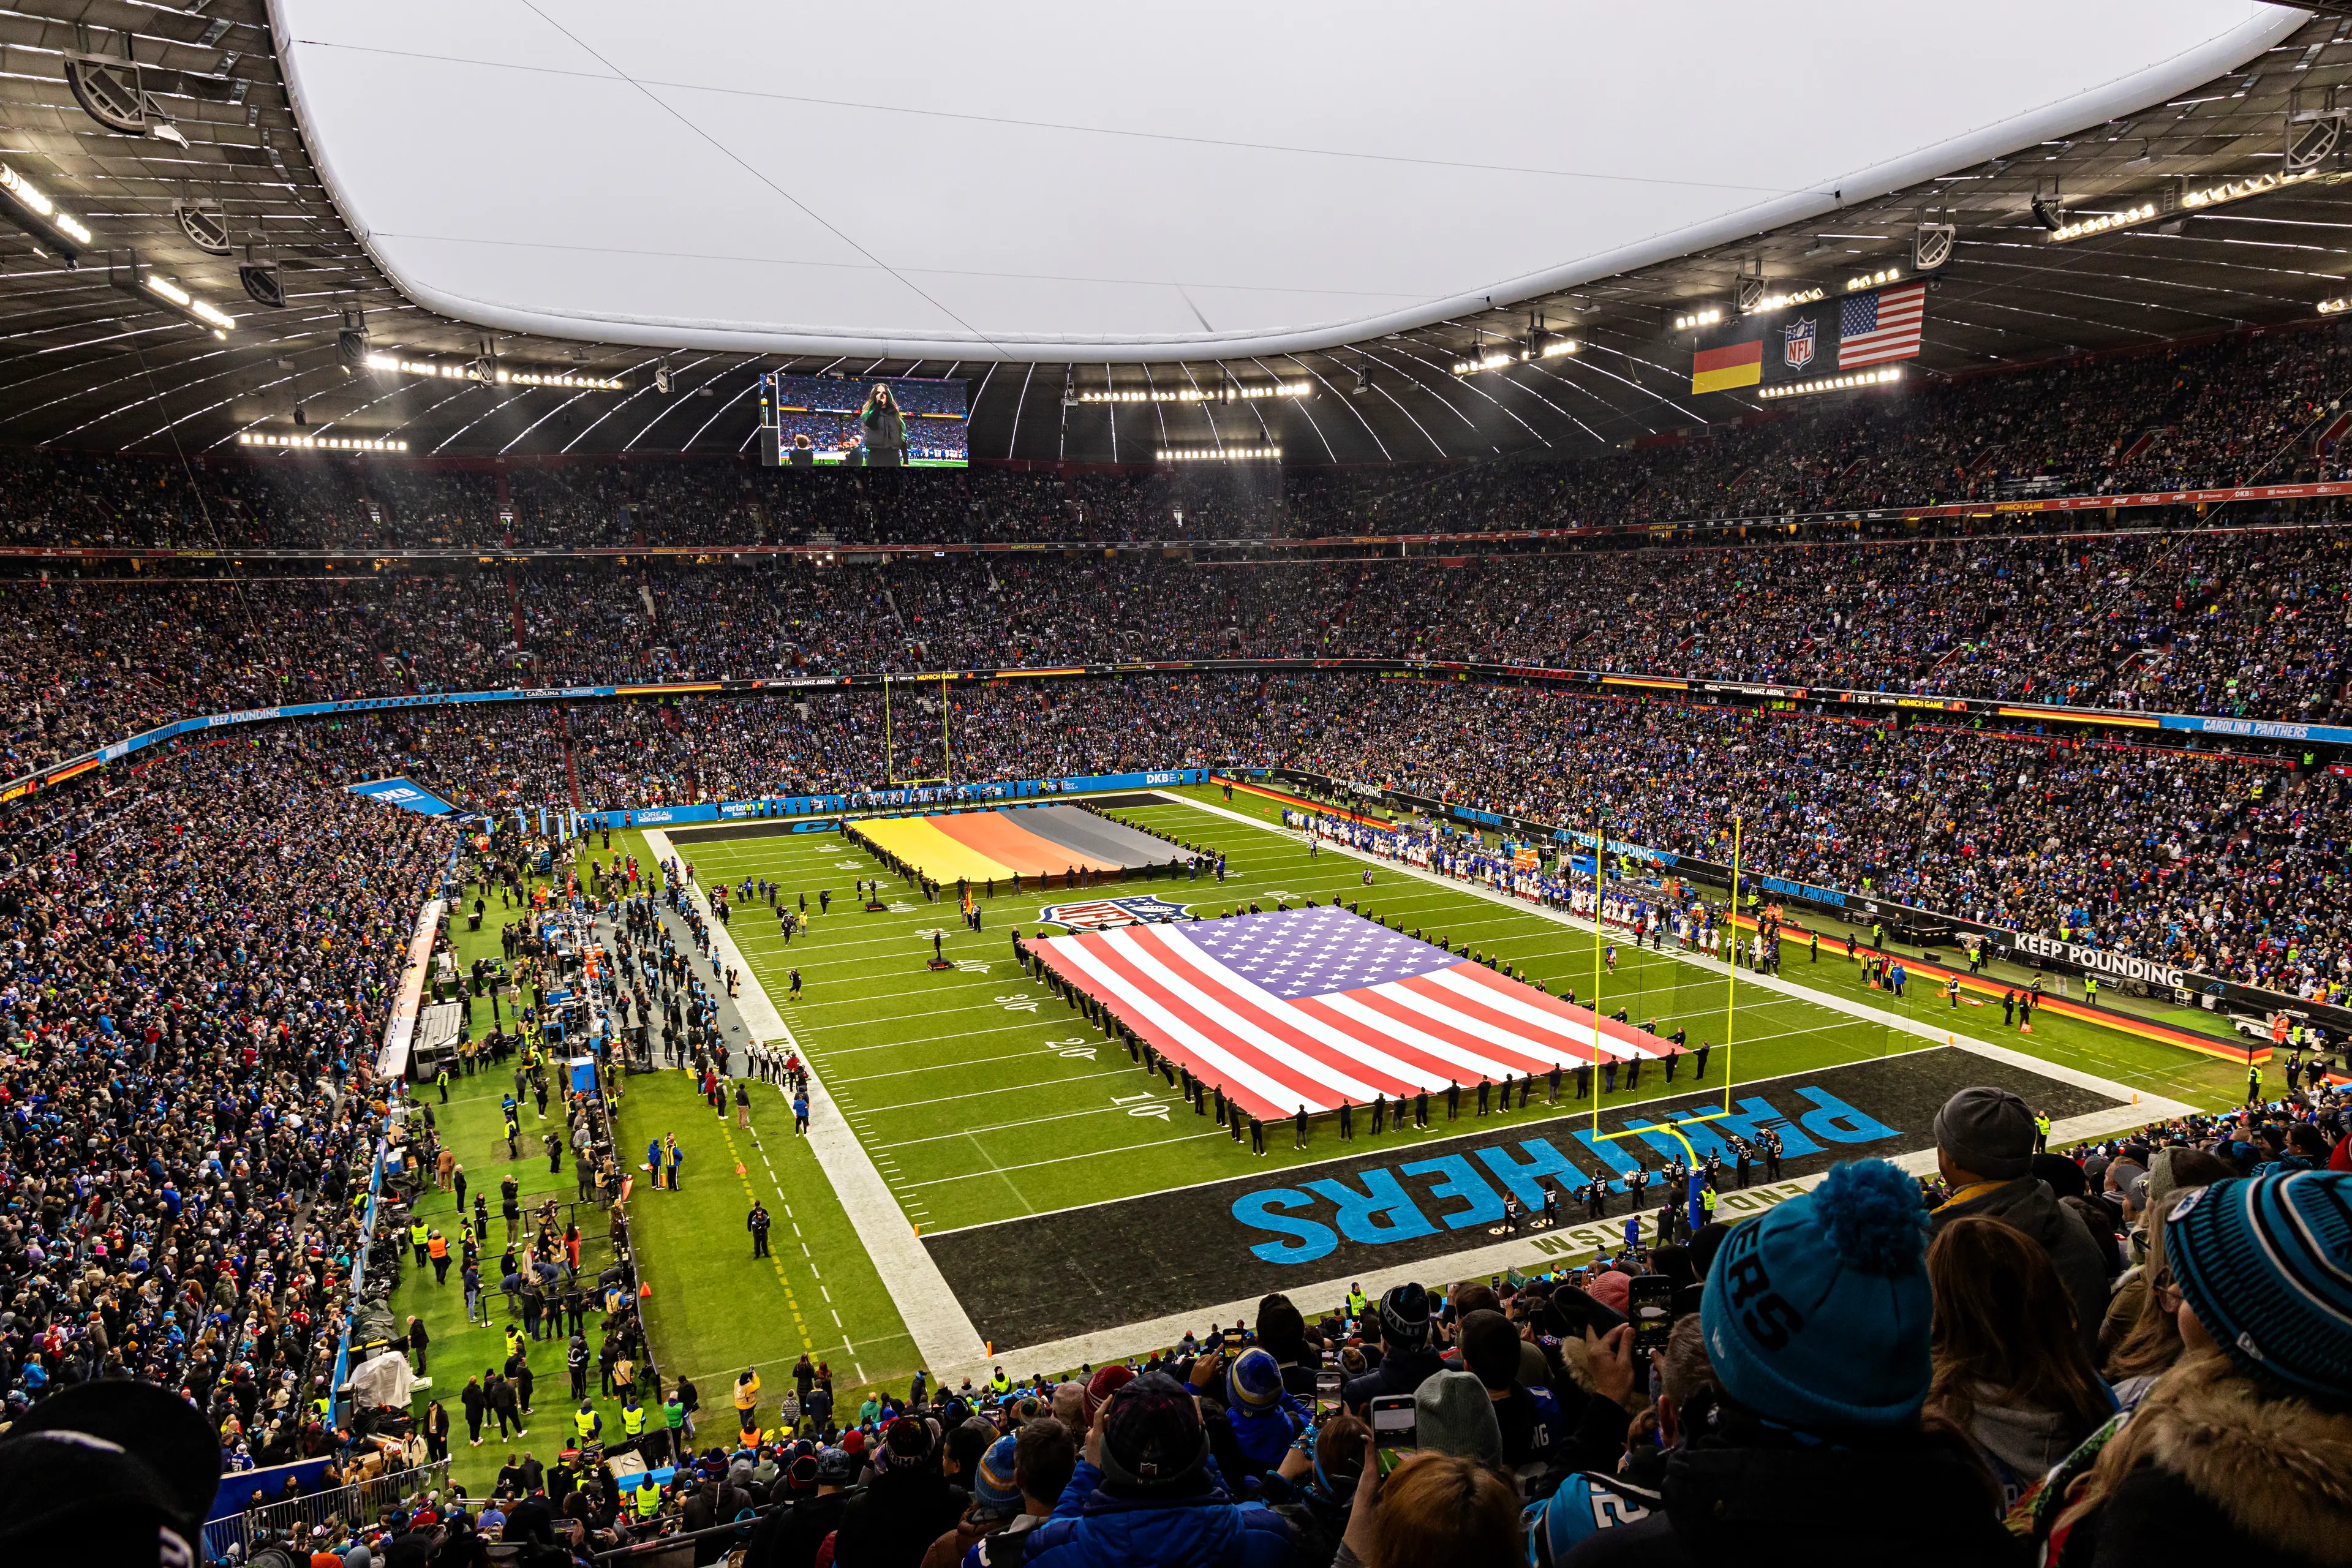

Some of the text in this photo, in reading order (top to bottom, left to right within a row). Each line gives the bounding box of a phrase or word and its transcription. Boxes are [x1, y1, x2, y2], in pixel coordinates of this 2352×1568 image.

[1789, 339, 1811, 363] NFL
[1898, 699, 1924, 707] MUNICH
[209, 708, 280, 726] KEEP POUNDING
[2203, 719, 2309, 738] CAROLINA PANTHERS
[1048, 781, 1075, 791] FeEx
[1147, 773, 1169, 783] DKB
[370, 788, 417, 801] DKB
[1348, 783, 1382, 798] POUNDING
[722, 804, 755, 813] verizn
[1454, 806, 1502, 826] CAROLINA PANTHERS
[459, 814, 475, 823] MUNICH
[835, 861, 864, 870] 20
[1762, 876, 1846, 907] CAROLINA PANTHERS
[1055, 903, 1137, 926] NFL
[953, 959, 991, 973] 40
[2015, 933, 2184, 988] KEEP POUNDING
[994, 993, 1039, 1011] 30
[1045, 1038, 1098, 1058] 20
[1110, 1091, 1170, 1117] 10
[1232, 1086, 1904, 1264] PANTHERS
[1640, 1174, 1648, 1183] 00
[1597, 1183, 1606, 1192] 00
[1548, 1194, 1556, 1203] 00
[1722, 1183, 1809, 1211] END
